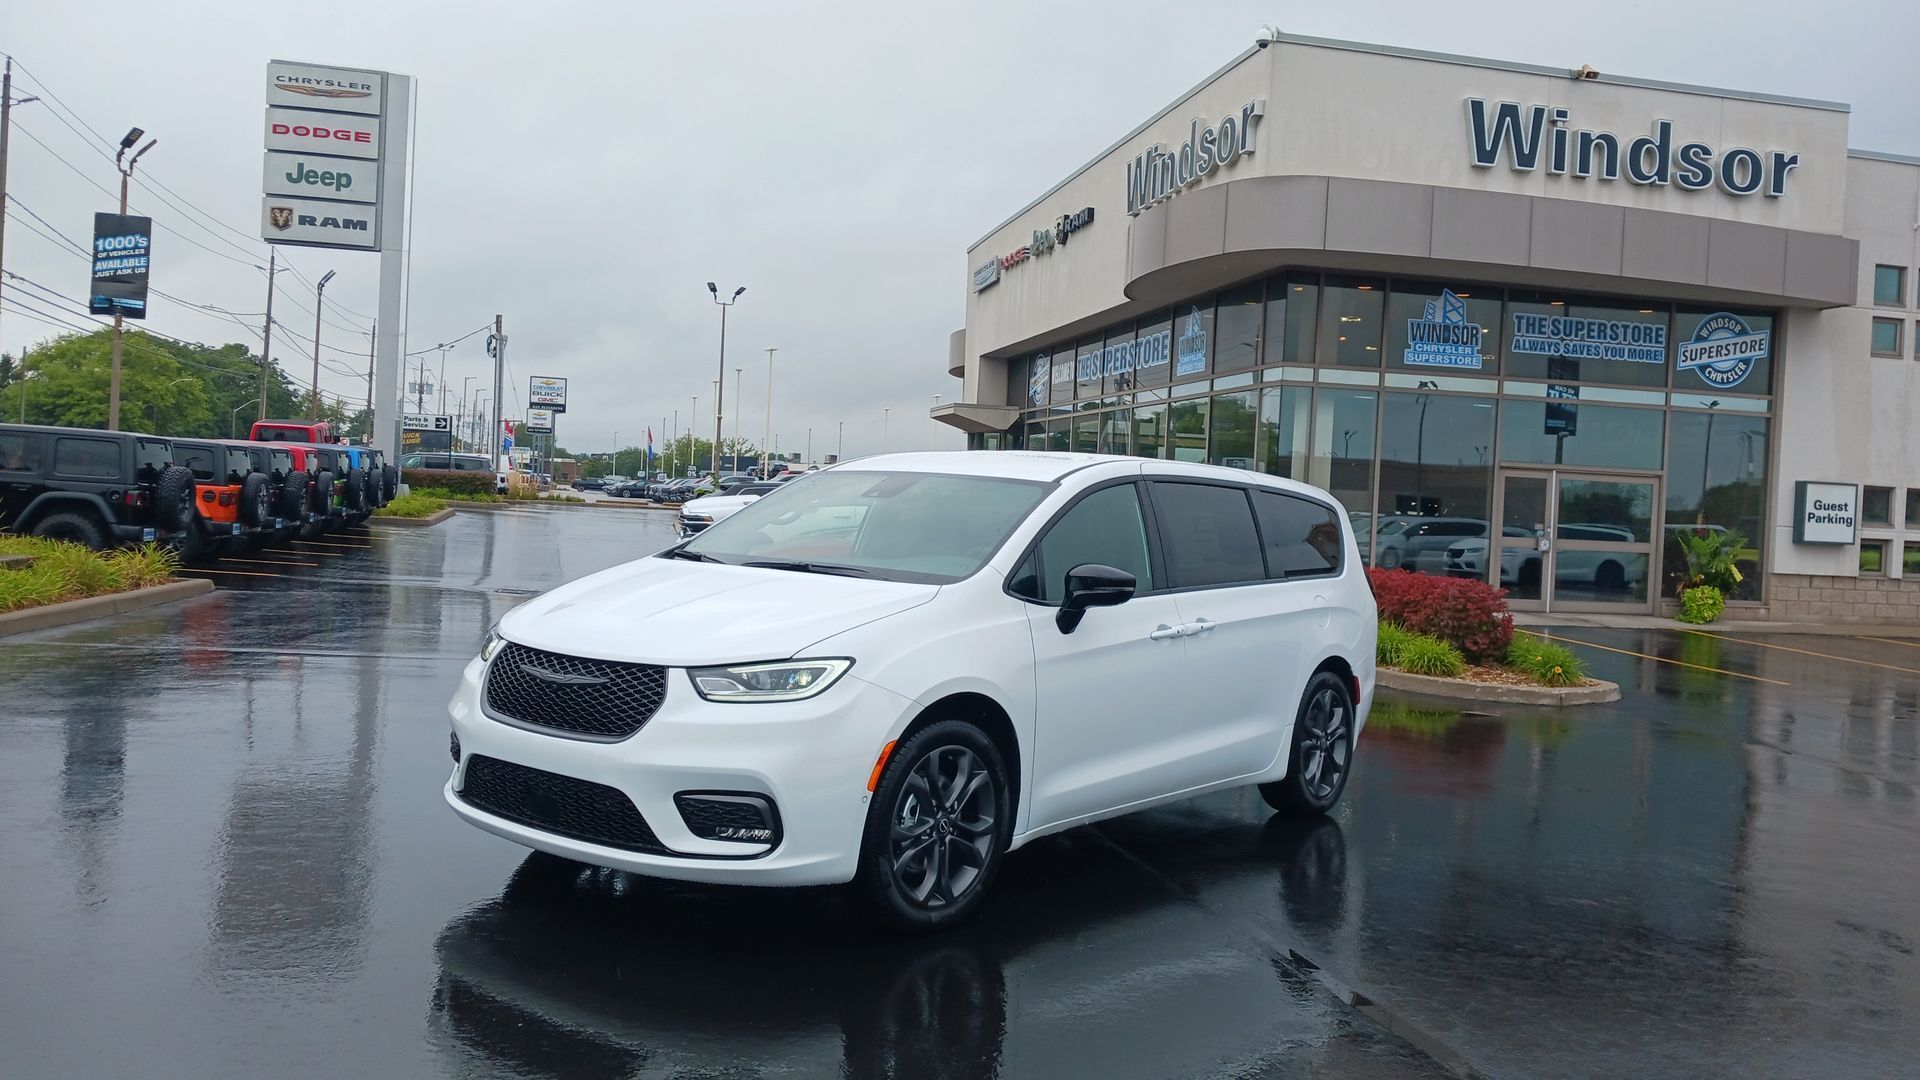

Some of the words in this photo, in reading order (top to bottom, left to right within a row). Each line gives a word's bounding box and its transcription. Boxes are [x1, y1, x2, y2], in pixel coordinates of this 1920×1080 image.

[276, 75, 372, 91] CHRYSLER
[272, 123, 371, 143] DODGE
[1465, 97, 1800, 198] Windsor
[1126, 100, 1265, 217] Windsor
[285, 162, 353, 192] Jeep
[297, 214, 368, 231] RAM
[1064, 207, 1095, 233] RAM
[95, 235, 148, 251] 1000'S
[109, 249, 145, 257] VEHICLES
[95, 257, 147, 271] AVAILABLE
[95, 270, 114, 278] JUST
[116, 268, 133, 276] ASK
[1410, 321, 1479, 346] WINDSOR
[1515, 315, 1547, 336] THE
[1549, 318, 1665, 345] SUPERSTORE
[1700, 318, 1742, 338] WINDSOR
[1077, 355, 1090, 381] THE
[1091, 331, 1170, 380] SUPERSTORE
[1407, 352, 1480, 366] SUPERSTORE
[1415, 343, 1472, 355] CHRYSLER
[1514, 338, 1561, 354] ALWAYS
[1563, 342, 1601, 357] SAVES
[1602, 346, 1626, 359] YOU
[1627, 347, 1663, 362] MORE!
[1681, 338, 1765, 363] SUPERSTORE
[1705, 361, 1747, 383] CHRYSLER
[1813, 499, 1849, 512] Guest
[1807, 512, 1853, 527] Parking
